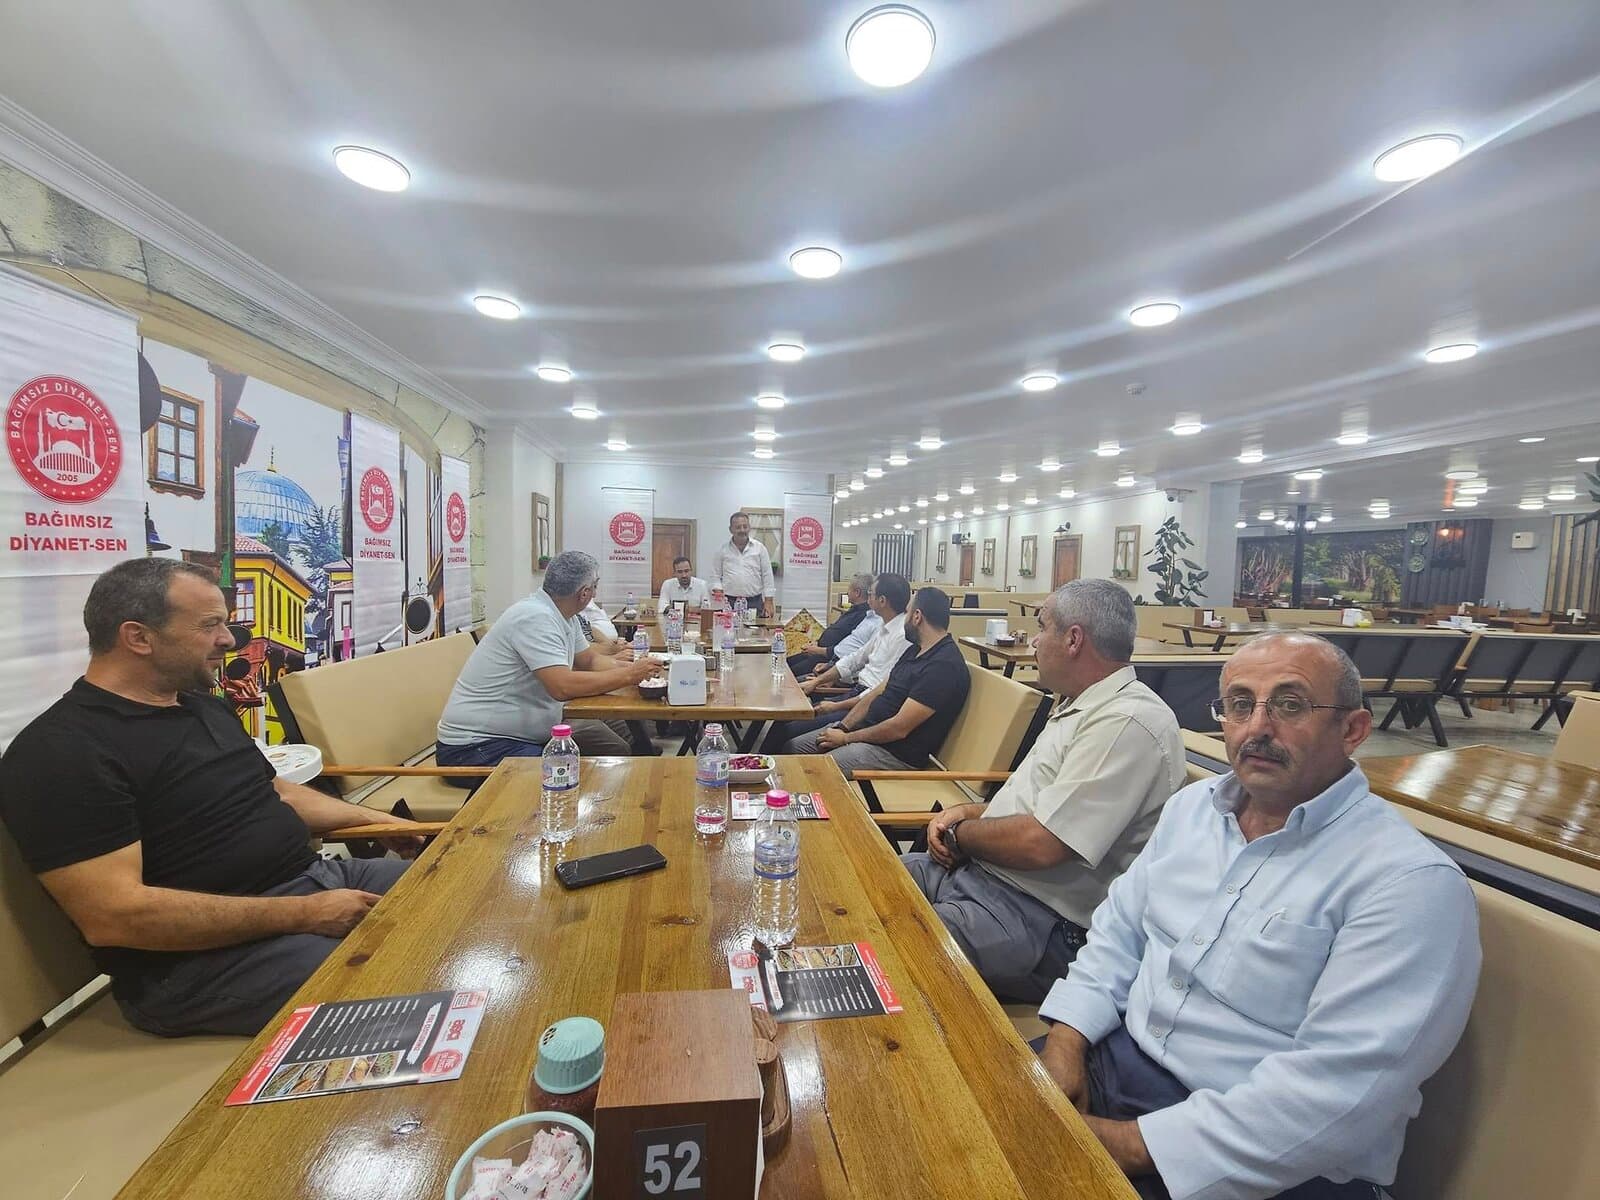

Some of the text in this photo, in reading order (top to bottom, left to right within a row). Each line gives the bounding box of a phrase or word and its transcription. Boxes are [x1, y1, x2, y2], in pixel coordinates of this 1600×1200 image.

[10, 382, 119, 454] BAĞIMSIZ DİYANET-SEN
[56, 473, 79, 483] 2005
[25, 510, 113, 529] BAĞIMSIZ
[10, 534, 127, 552] DİYANET-SEN
[643, 1140, 702, 1195] 52
